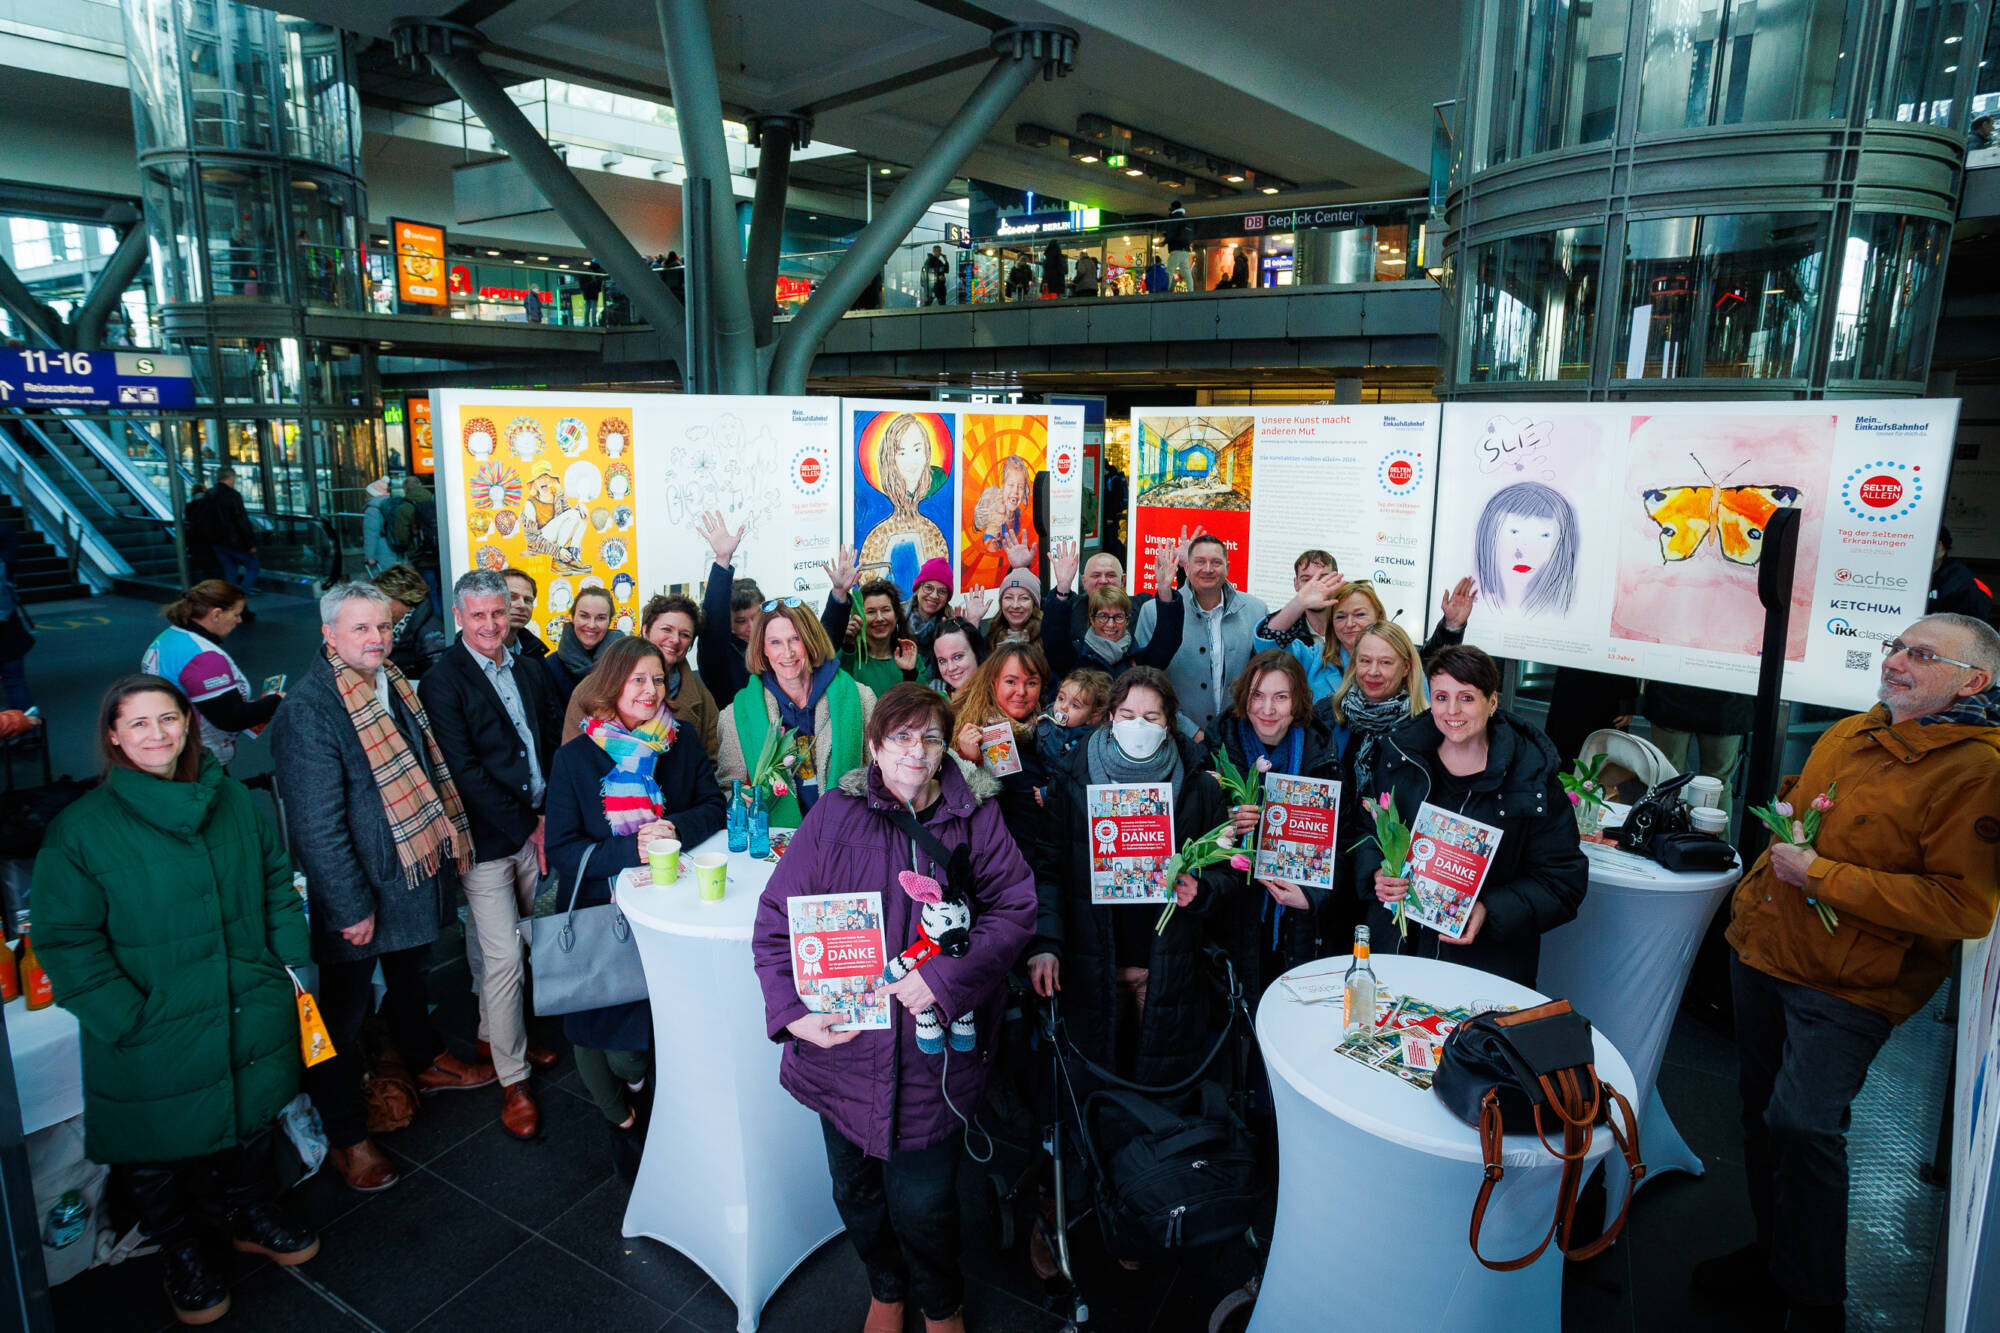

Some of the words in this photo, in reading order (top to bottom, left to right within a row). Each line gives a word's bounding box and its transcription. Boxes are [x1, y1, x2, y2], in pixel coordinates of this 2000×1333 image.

[1245, 216, 1264, 230] DB
[1315, 210, 1355, 223] Center
[1042, 222, 1070, 232] BERLIN
[479, 286, 553, 304] APOTHKE
[18, 349, 93, 375] 11-16
[23, 382, 95, 394] Reisezentrum
[1261, 416, 1292, 424] Unsere
[1294, 416, 1319, 424] Kunst
[1322, 416, 1351, 424] macht
[1261, 428, 1296, 436] anderen
[1298, 427, 1315, 435] Mut
[1855, 423, 1929, 431] EinkaufsBahnhof
[1863, 484, 1901, 492] SELTEN
[1862, 492, 1900, 500] ALLEIN
[1838, 529, 1853, 537] Tag
[1872, 531, 1914, 540] Seltenen
[1842, 538, 1907, 547] Erkrankungen
[1374, 556, 1415, 566] KETCHUM
[1852, 571, 1908, 588] achse
[1830, 599, 1901, 615] KETCHUM
[1289, 819, 1329, 833] DANKE
[1121, 831, 1165, 842] DANKE
[1434, 856, 1477, 881] DANKE
[827, 947, 876, 961] DANKE
